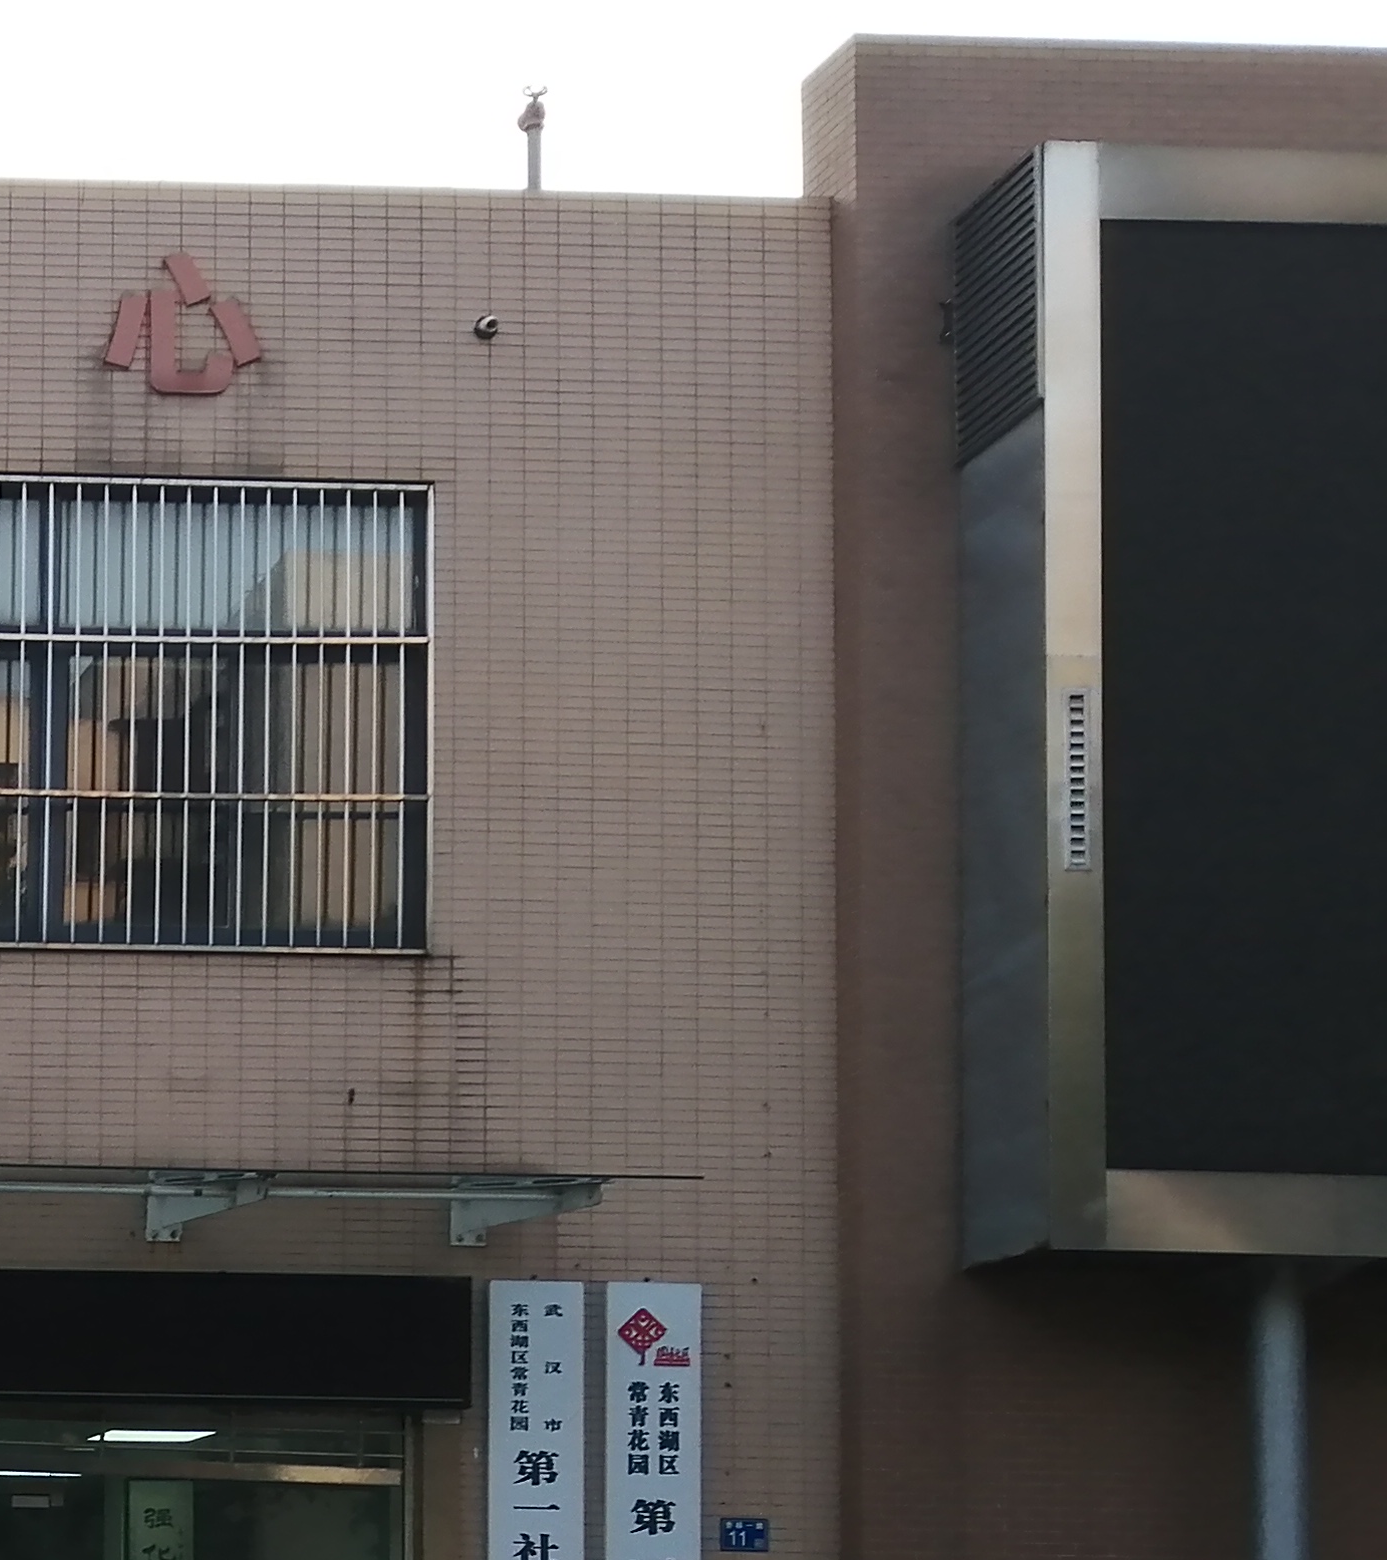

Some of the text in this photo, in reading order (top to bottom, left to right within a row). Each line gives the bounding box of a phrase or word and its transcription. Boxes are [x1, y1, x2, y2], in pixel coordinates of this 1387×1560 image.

[510, 1303, 529, 1432] 东西湖区常青花园
[543, 1304, 563, 1432] 武汉市
[628, 1381, 650, 1475] 常青花园
[658, 1382, 680, 1475] 东西湖区
[728, 1530, 746, 1547] 11
